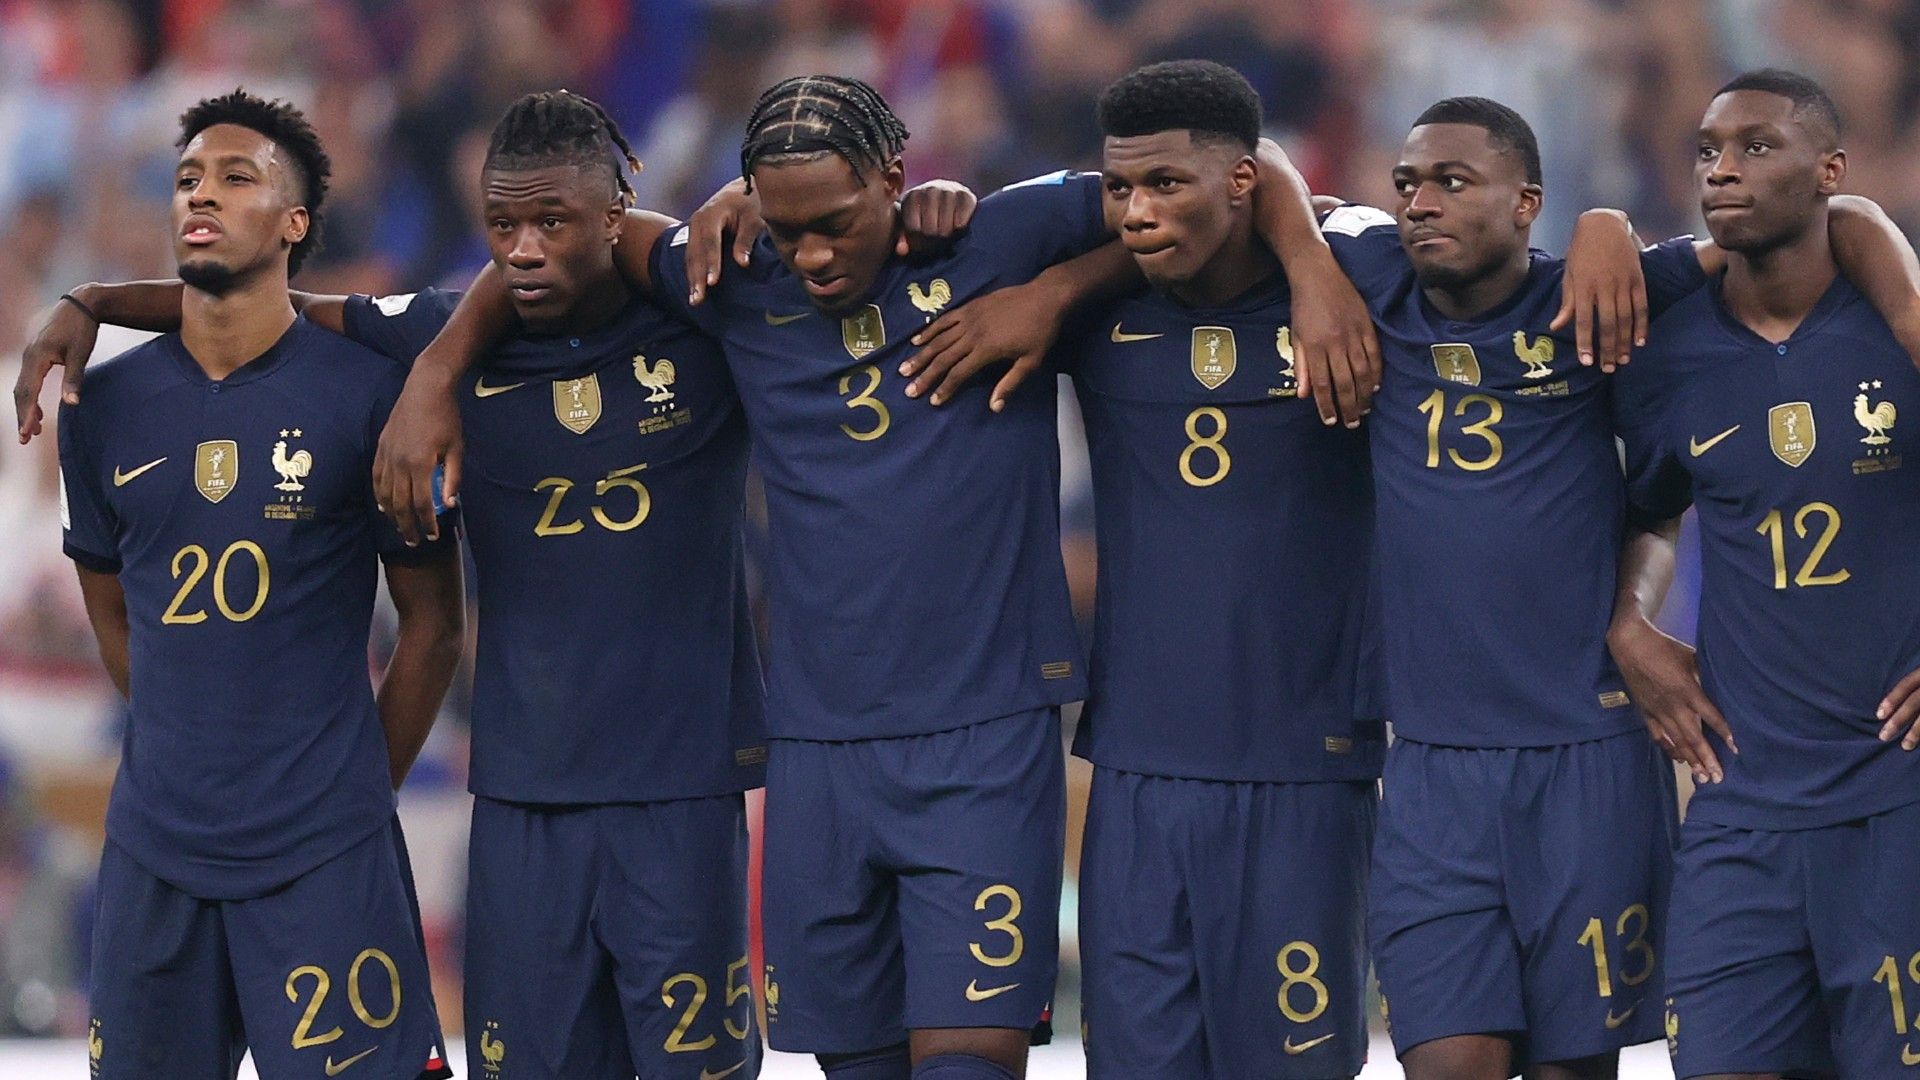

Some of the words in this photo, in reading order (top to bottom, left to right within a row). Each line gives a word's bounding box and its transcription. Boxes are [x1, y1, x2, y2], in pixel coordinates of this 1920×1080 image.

[839, 366, 890, 441] 3
[1204, 365, 1222, 373] FIFA
[569, 409, 590, 419] FIFA
[1179, 406, 1231, 487] 8
[1418, 388, 1503, 471] 13
[1784, 442, 1804, 452] FIFA
[207, 479, 225, 487] FIFA
[534, 464, 650, 537] 25
[161, 540, 269, 624] 20
[1756, 502, 1851, 590] 12
[970, 885, 1023, 967] 3
[1578, 903, 1656, 998] 13
[286, 949, 400, 1049] 20
[661, 953, 751, 1053] 25
[1277, 941, 1328, 1023] 8
[1873, 951, 1920, 1034] 1
